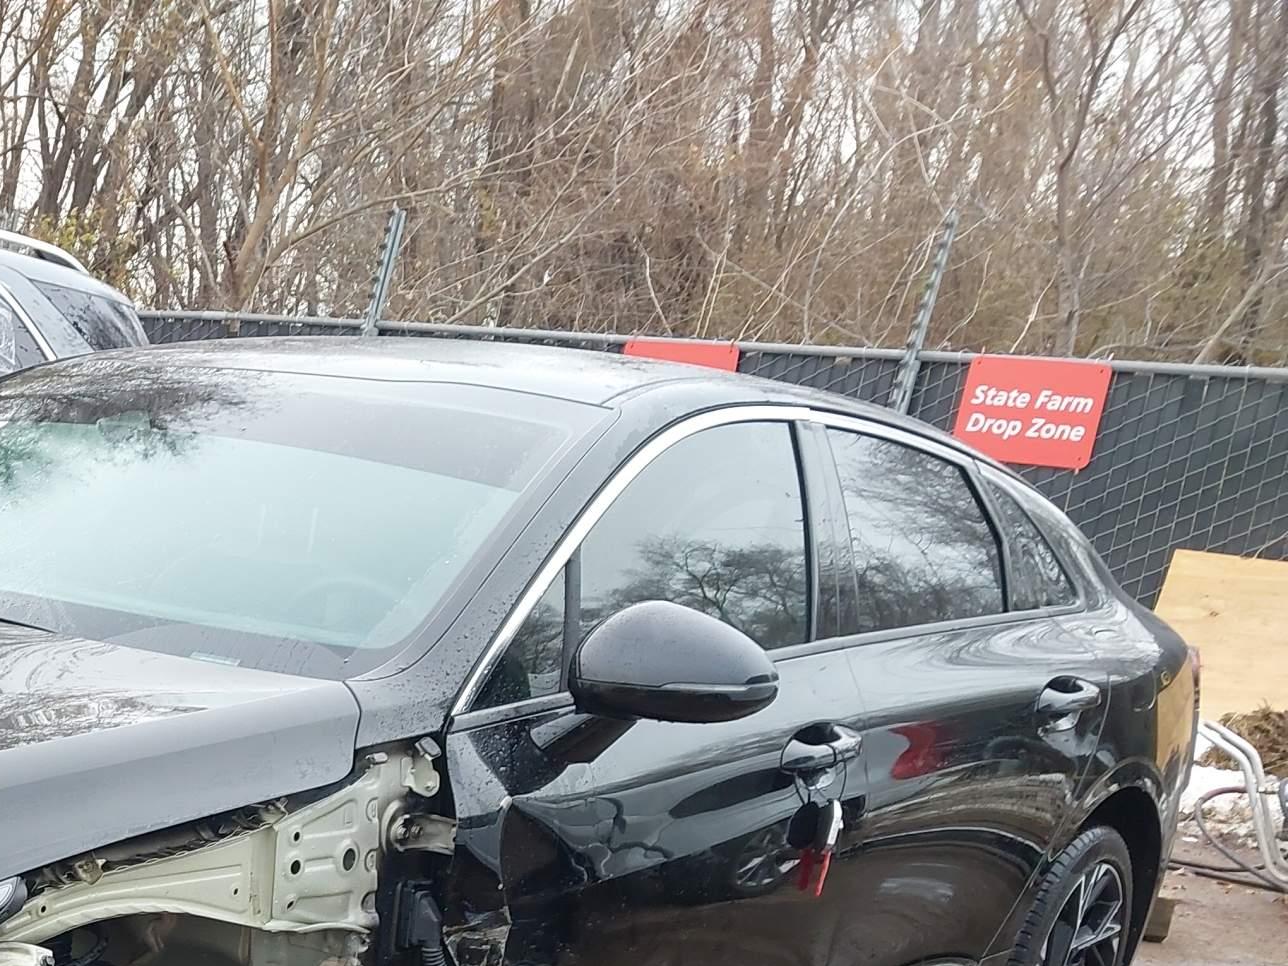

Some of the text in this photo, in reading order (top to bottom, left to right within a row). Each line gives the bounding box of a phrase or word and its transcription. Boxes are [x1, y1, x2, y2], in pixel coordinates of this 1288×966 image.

[970, 385, 1094, 413] State Farm
[965, 412, 1085, 442] Drop Zone
